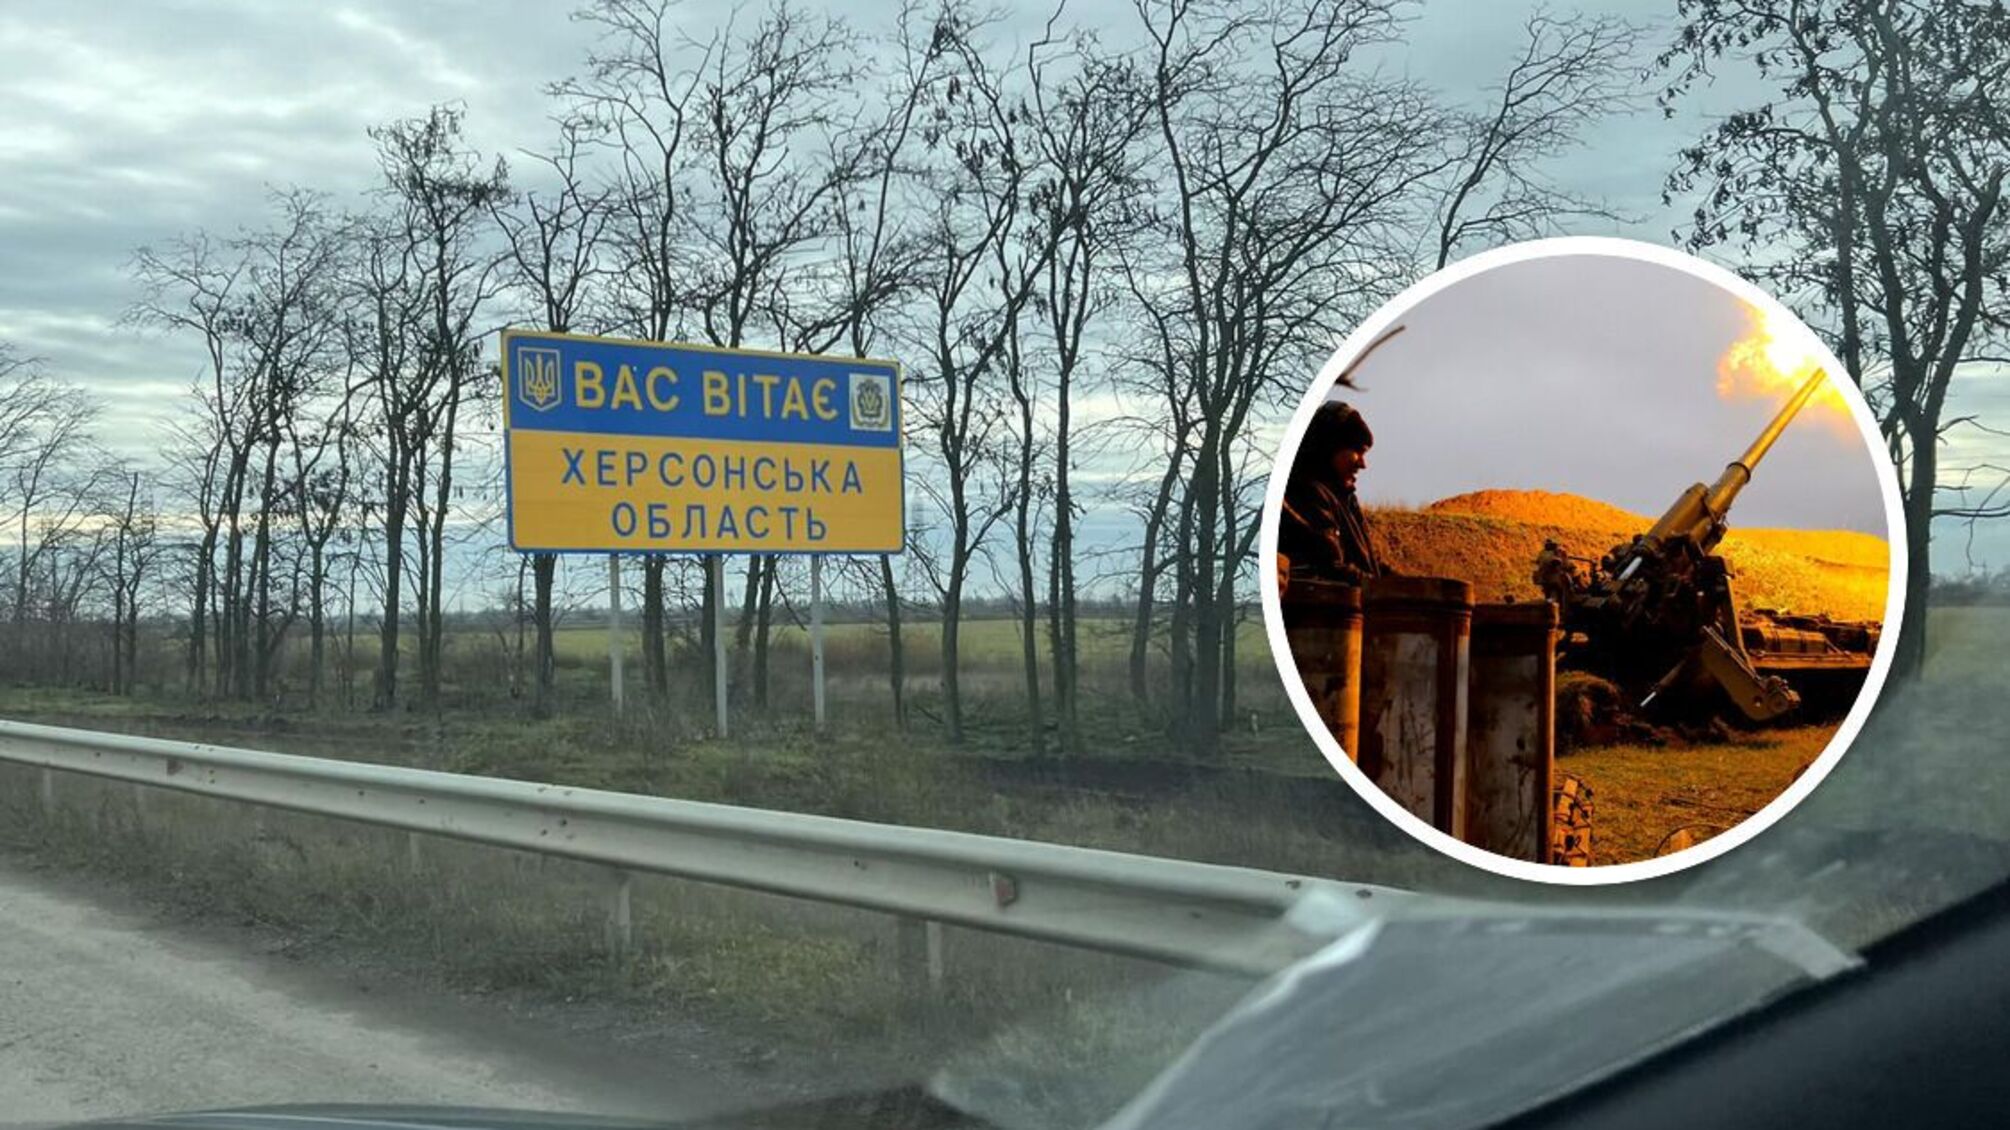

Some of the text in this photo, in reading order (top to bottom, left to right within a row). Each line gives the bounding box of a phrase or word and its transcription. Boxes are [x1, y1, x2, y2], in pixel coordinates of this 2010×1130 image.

[574, 361, 838, 421] ВАС ВІТАЄ
[561, 447, 863, 495] ХЕРСОНСЬКА
[611, 502, 827, 541] ОБЛАСТЬ
